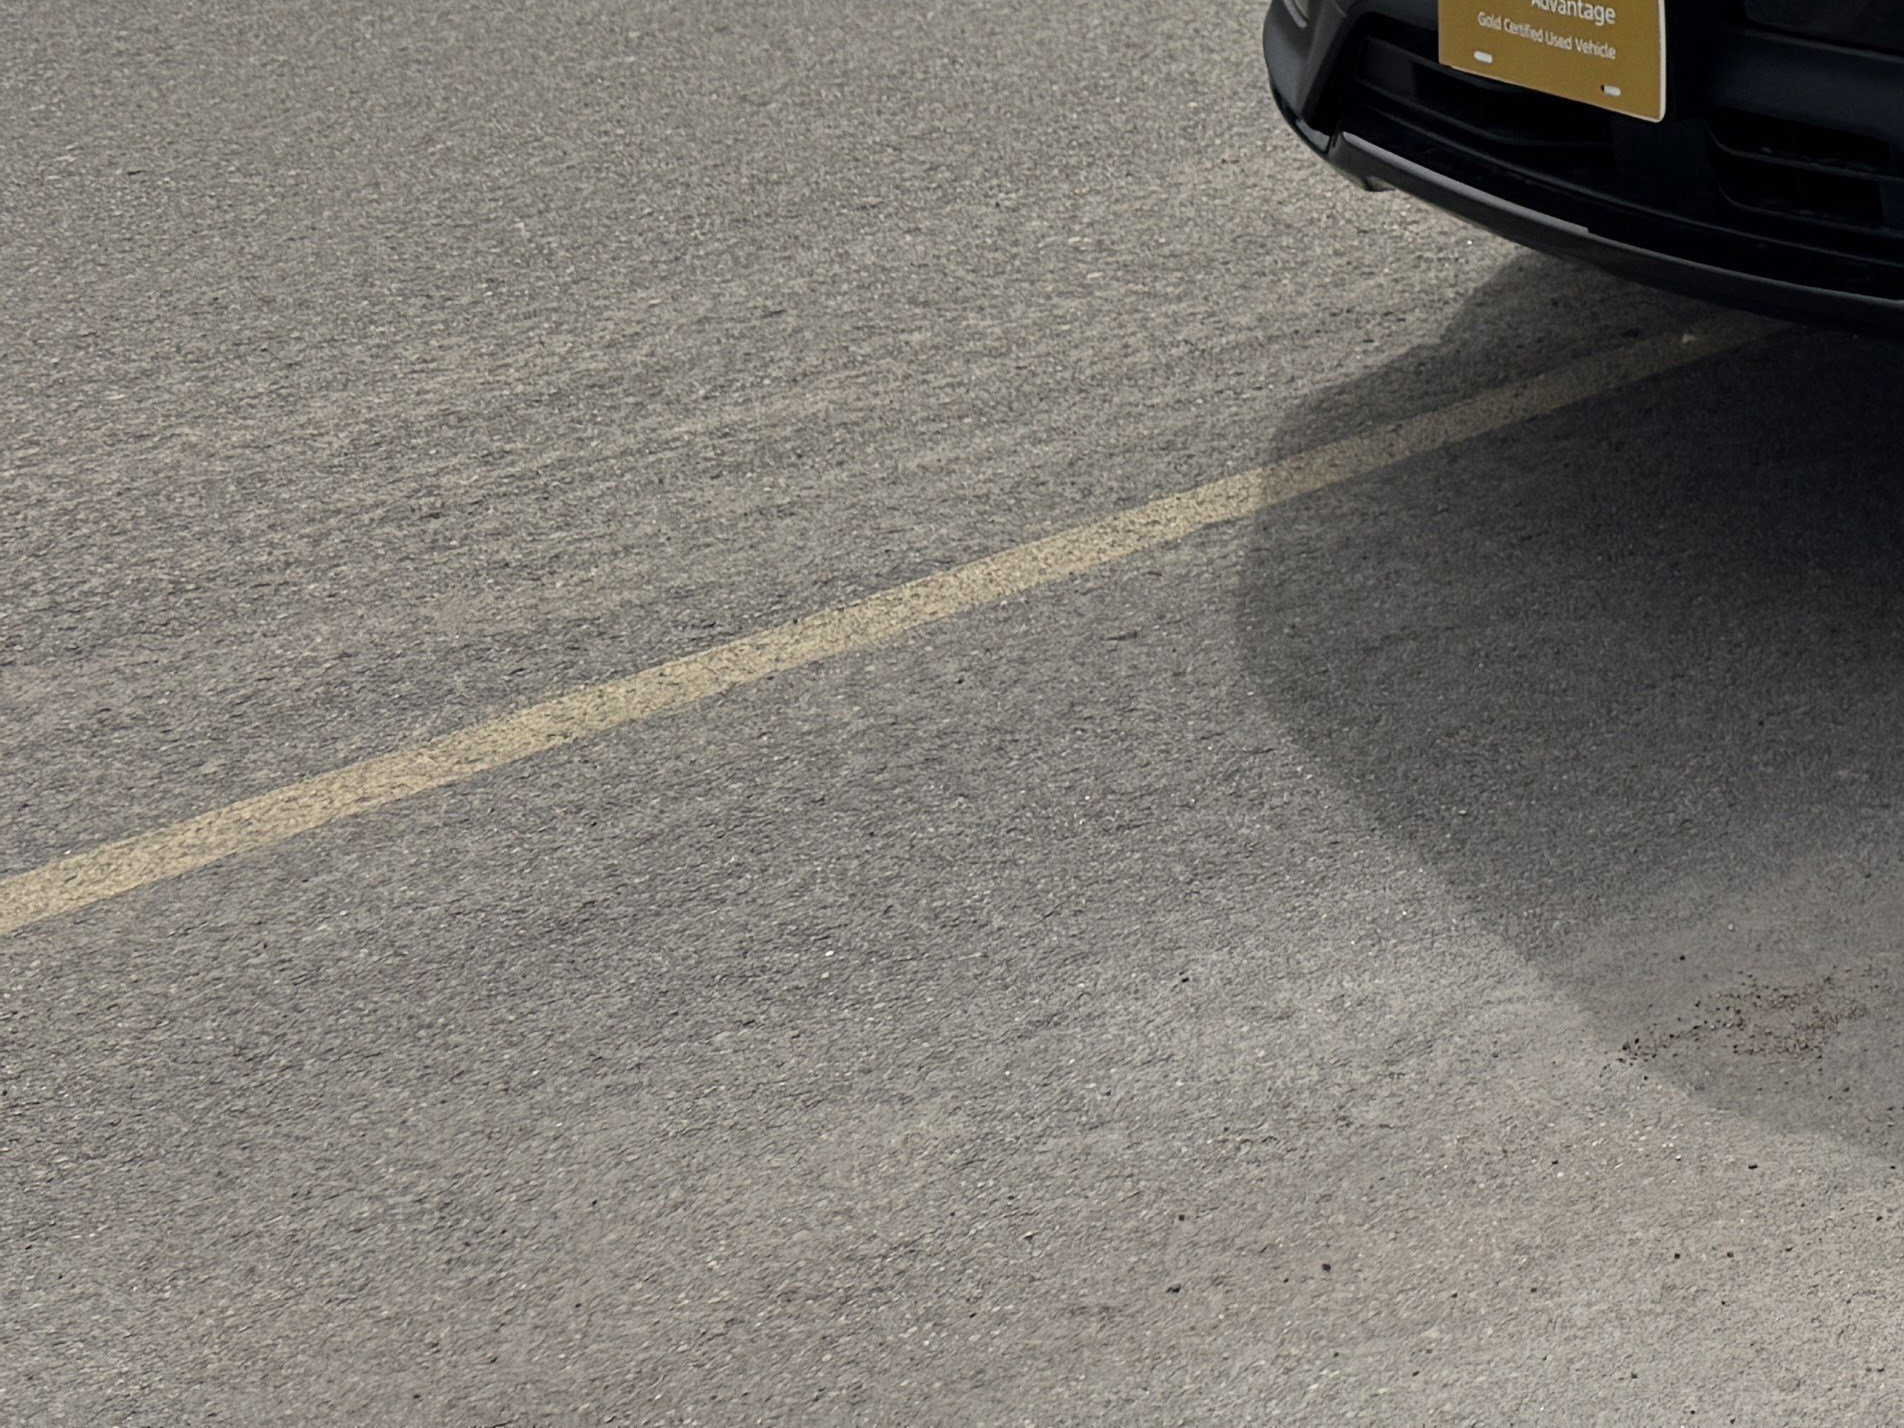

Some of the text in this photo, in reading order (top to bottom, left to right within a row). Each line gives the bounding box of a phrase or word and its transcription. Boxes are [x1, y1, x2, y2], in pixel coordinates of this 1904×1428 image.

[1477, 11, 1616, 60] Gold Certified Used Vehicle
